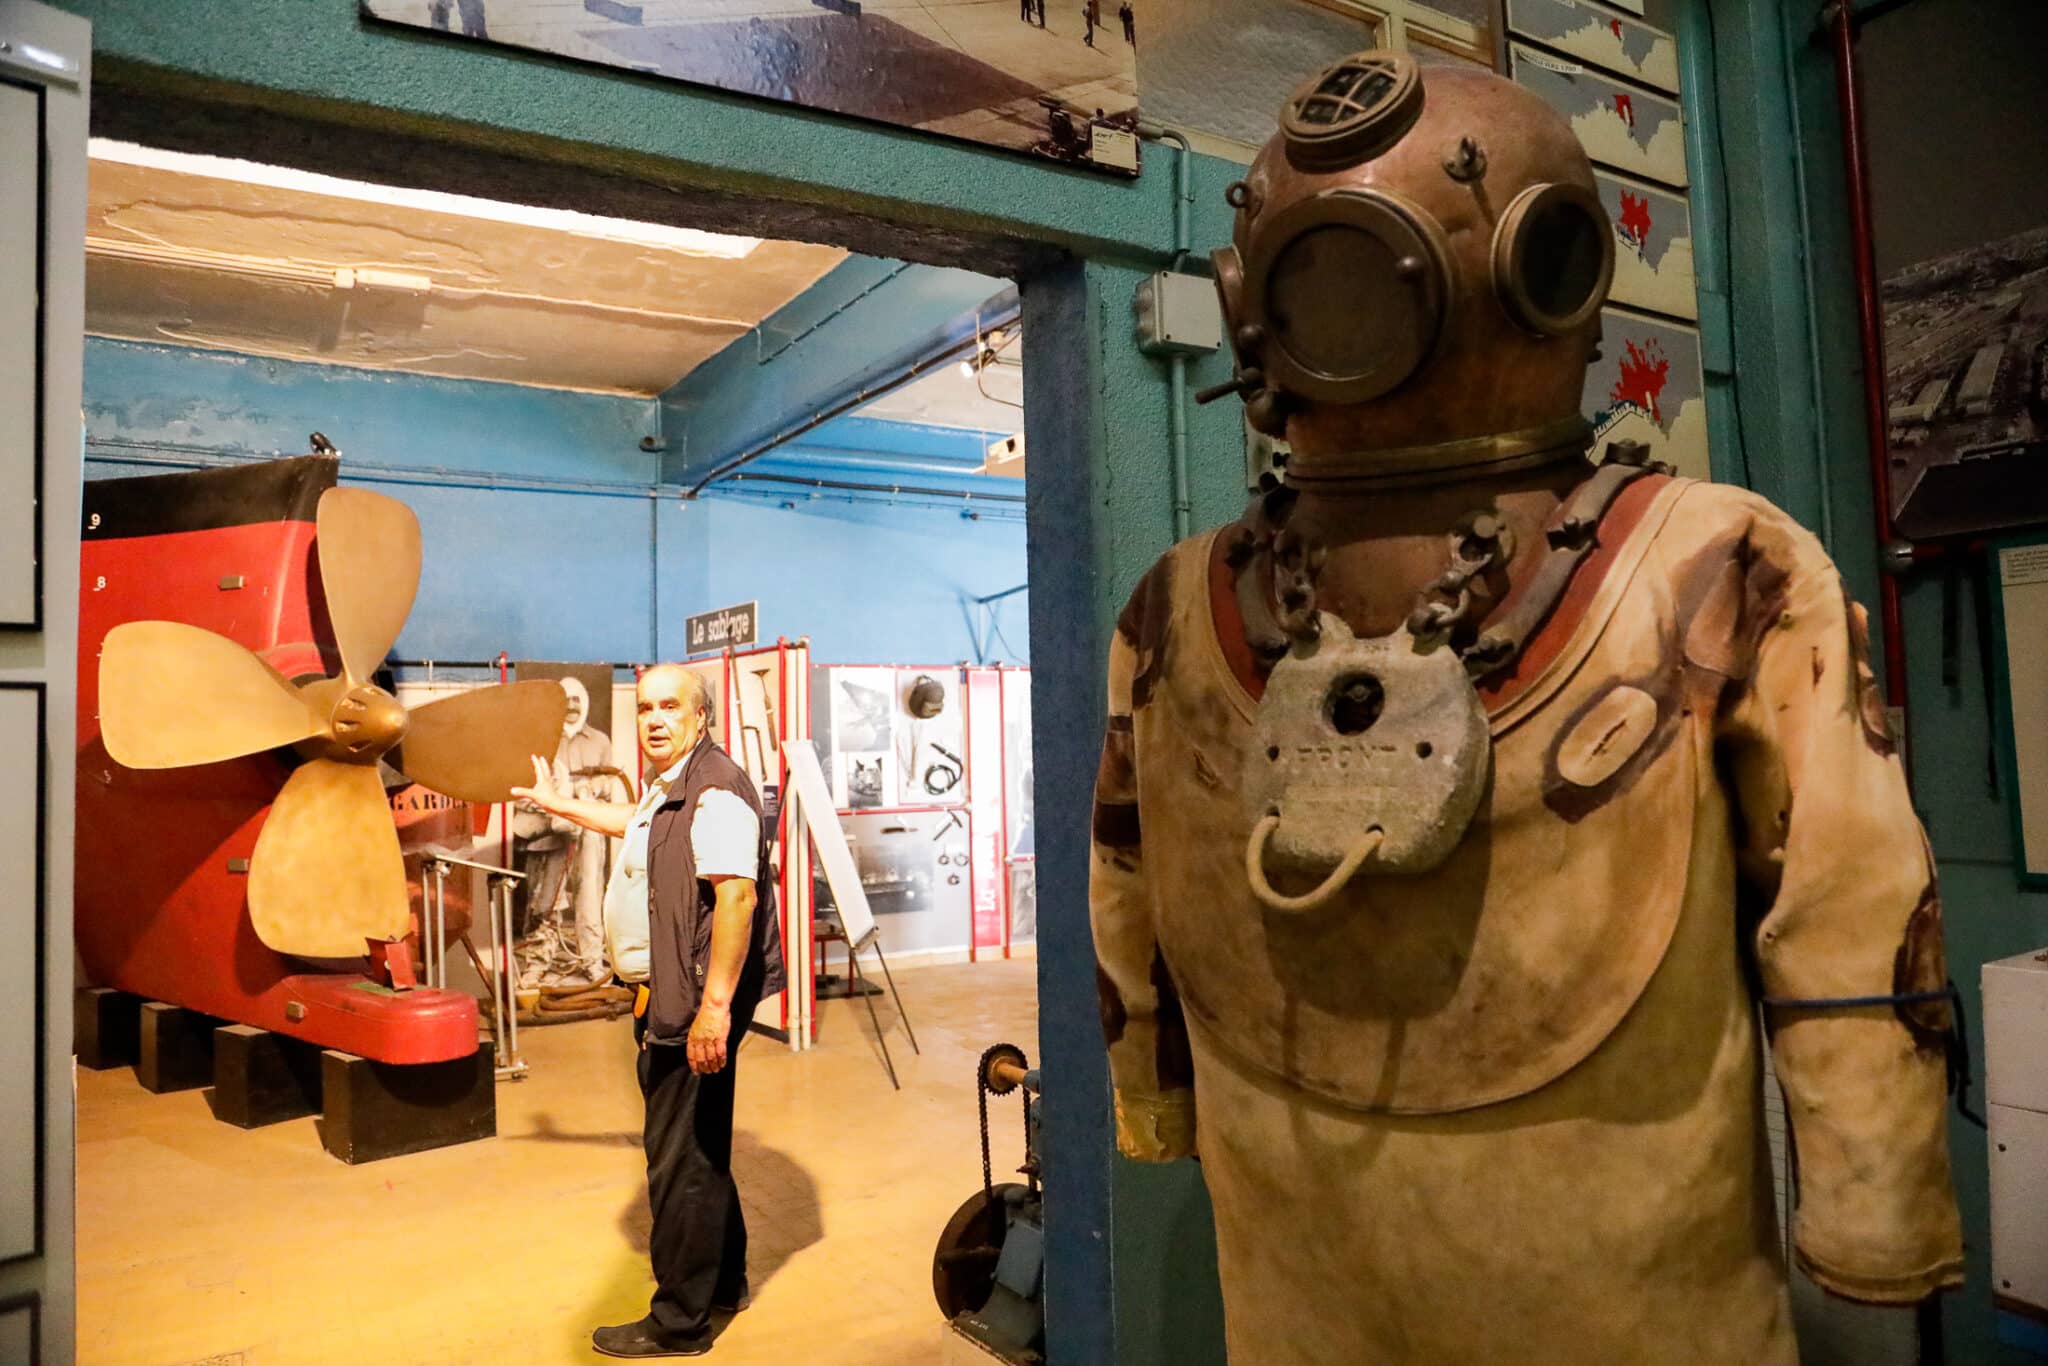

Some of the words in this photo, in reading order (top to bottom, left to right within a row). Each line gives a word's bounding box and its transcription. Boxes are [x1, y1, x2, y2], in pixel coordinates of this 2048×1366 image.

[91, 513, 101, 527] 9
[97, 576, 106, 589] 8
[692, 619, 704, 645] Le
[708, 610, 750, 642] sablage
[1294, 744, 1398, 770] FRONT
